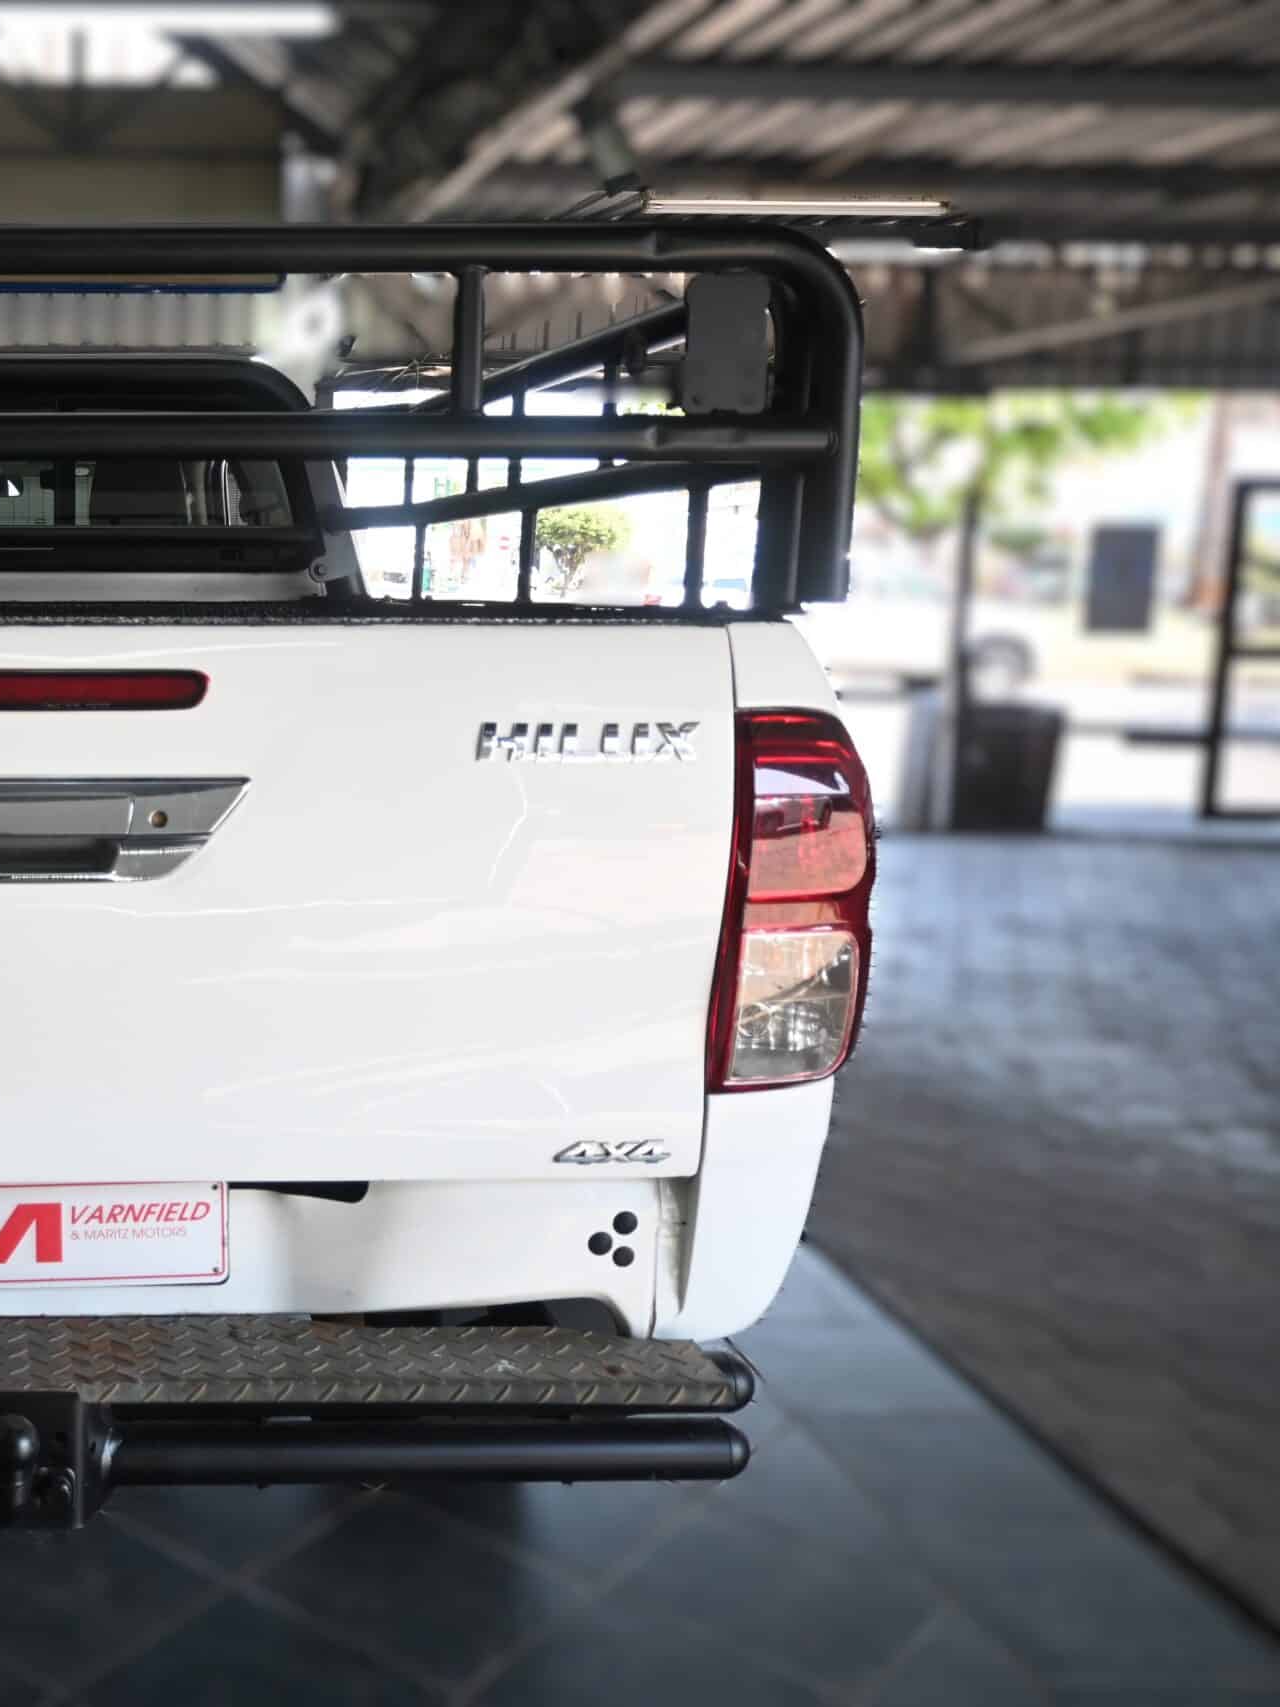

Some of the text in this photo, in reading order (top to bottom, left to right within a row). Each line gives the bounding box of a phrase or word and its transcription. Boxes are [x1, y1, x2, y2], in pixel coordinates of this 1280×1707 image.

[475, 720, 701, 763] HILUX
[70, 1201, 211, 1225] VARNFIELD
[71, 1226, 187, 1241] & MARITZ MOTORS
